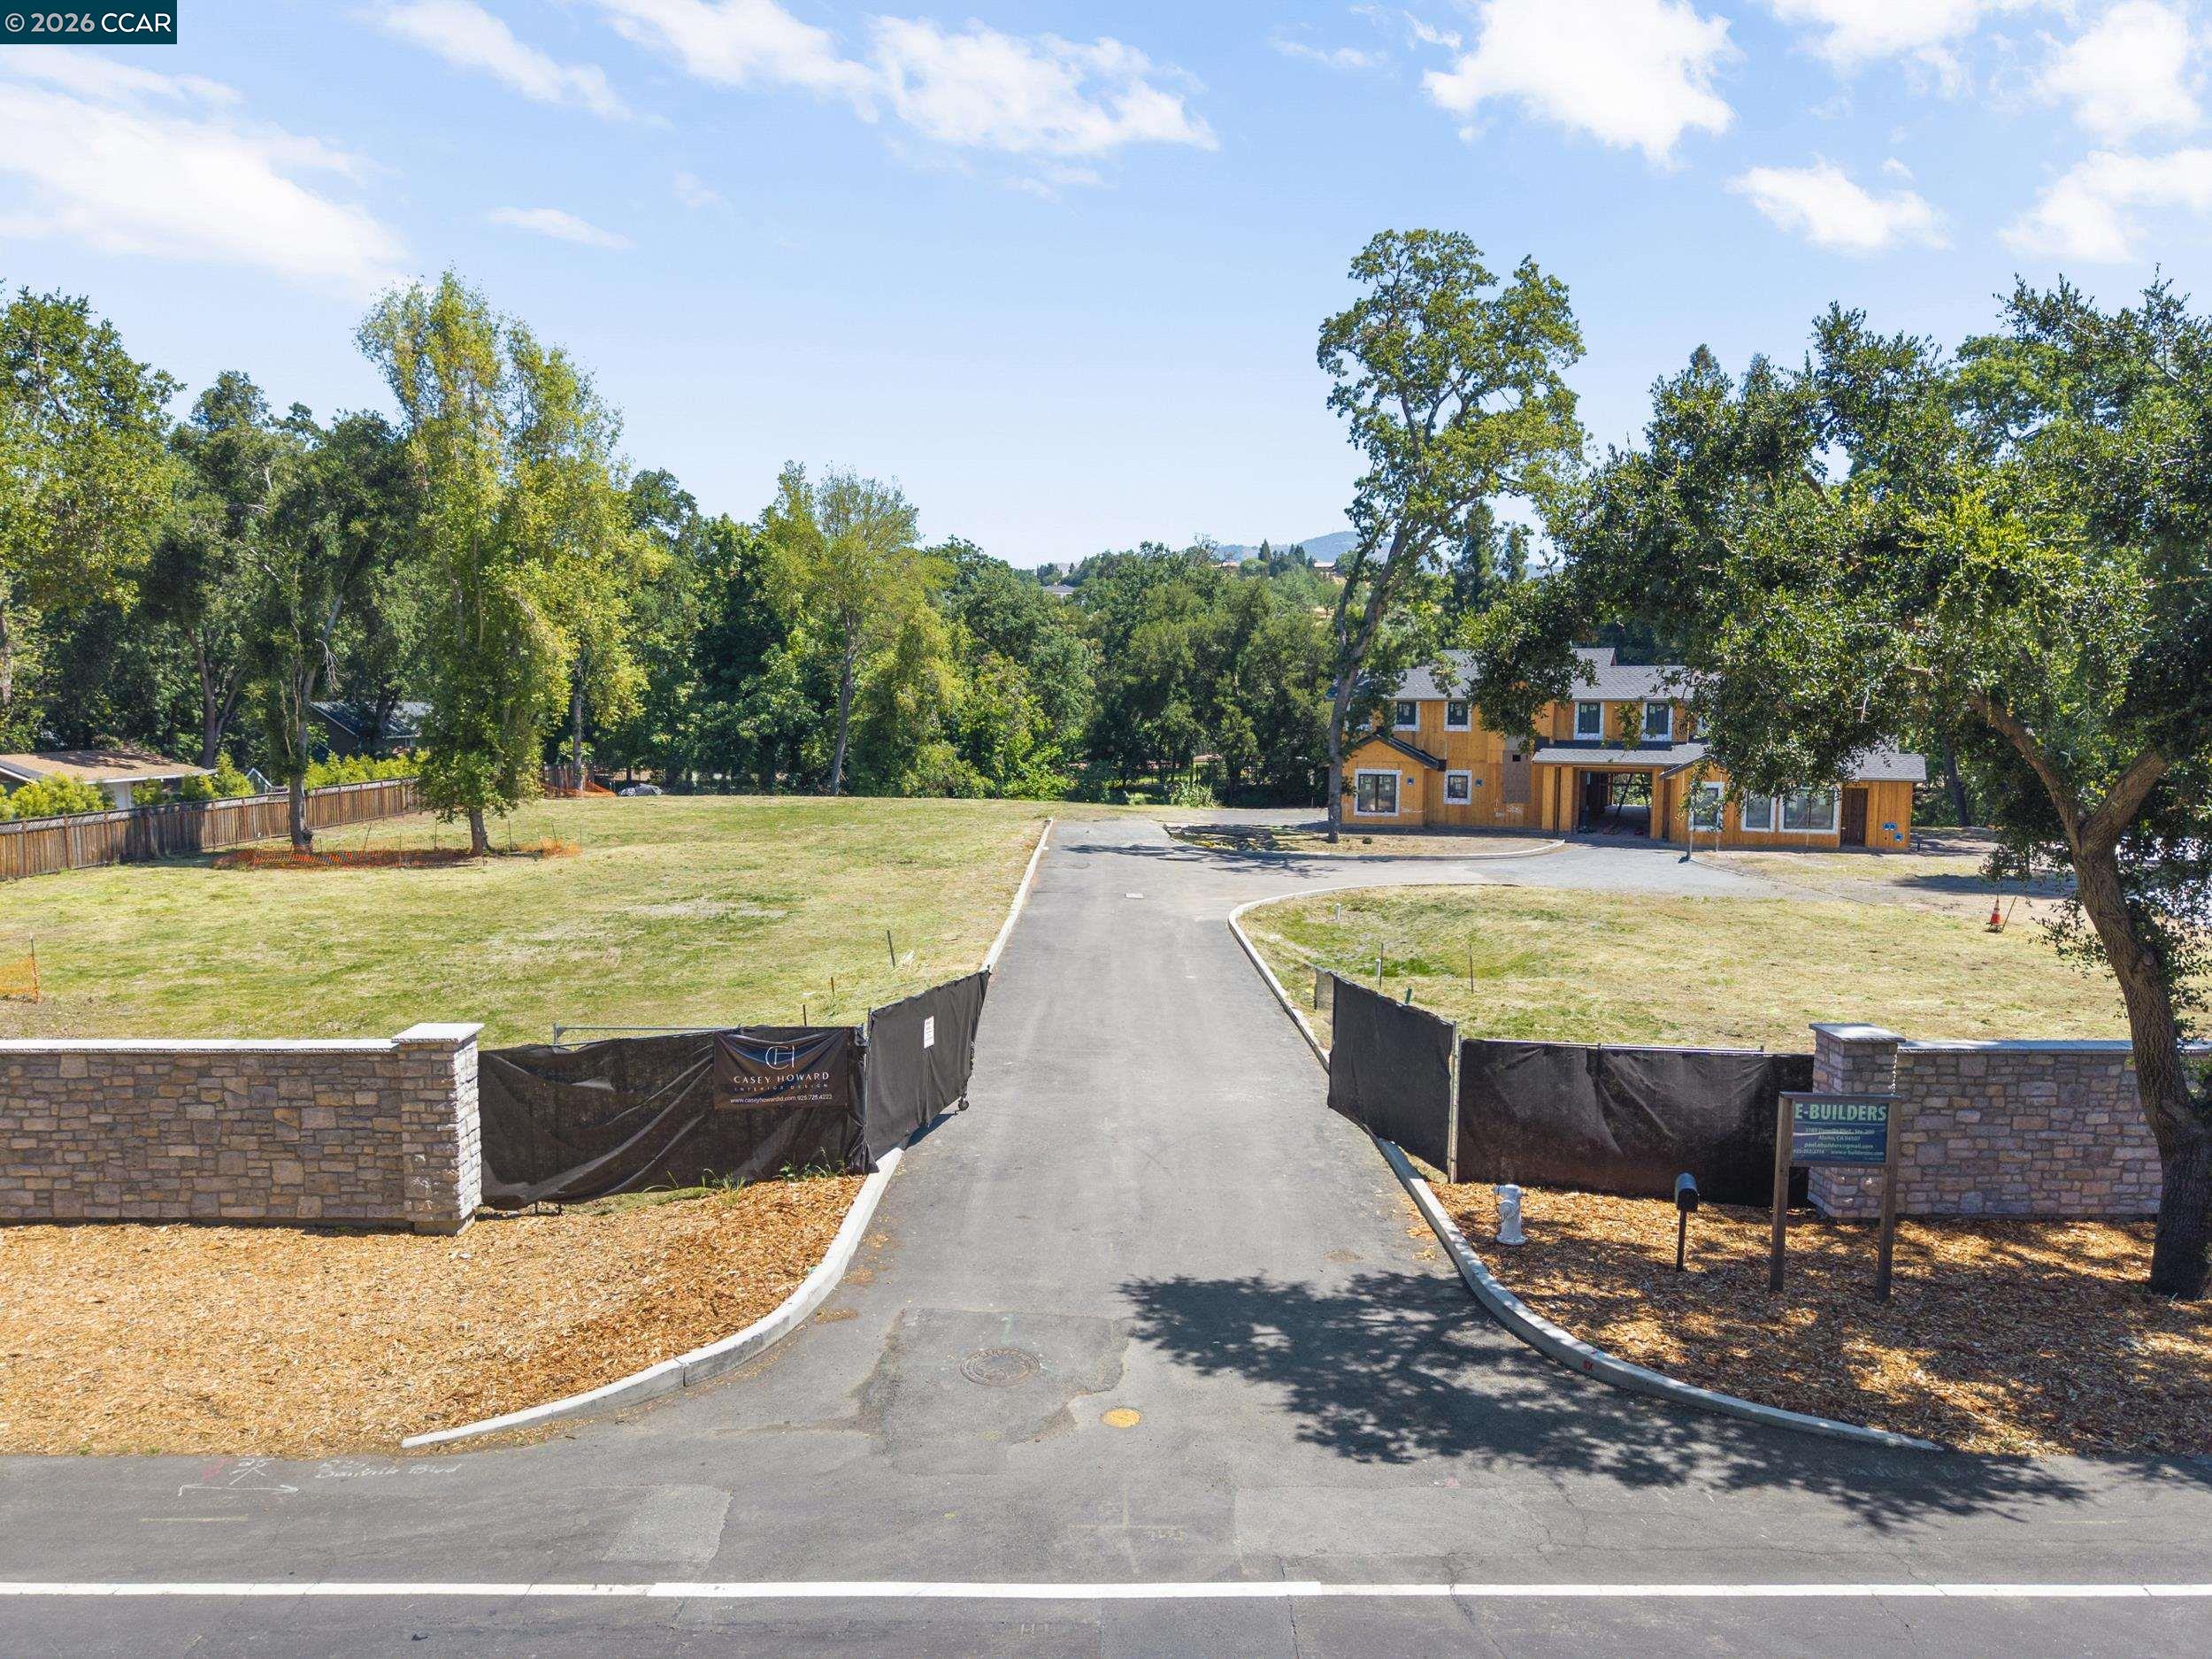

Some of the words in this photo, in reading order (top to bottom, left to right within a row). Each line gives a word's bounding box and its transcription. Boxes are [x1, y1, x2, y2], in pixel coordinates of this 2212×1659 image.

[733, 1075, 772, 1084] CASEY
[777, 1071, 830, 1082] HOWARD
[1794, 1103, 1887, 1121] E-BUILDERS
